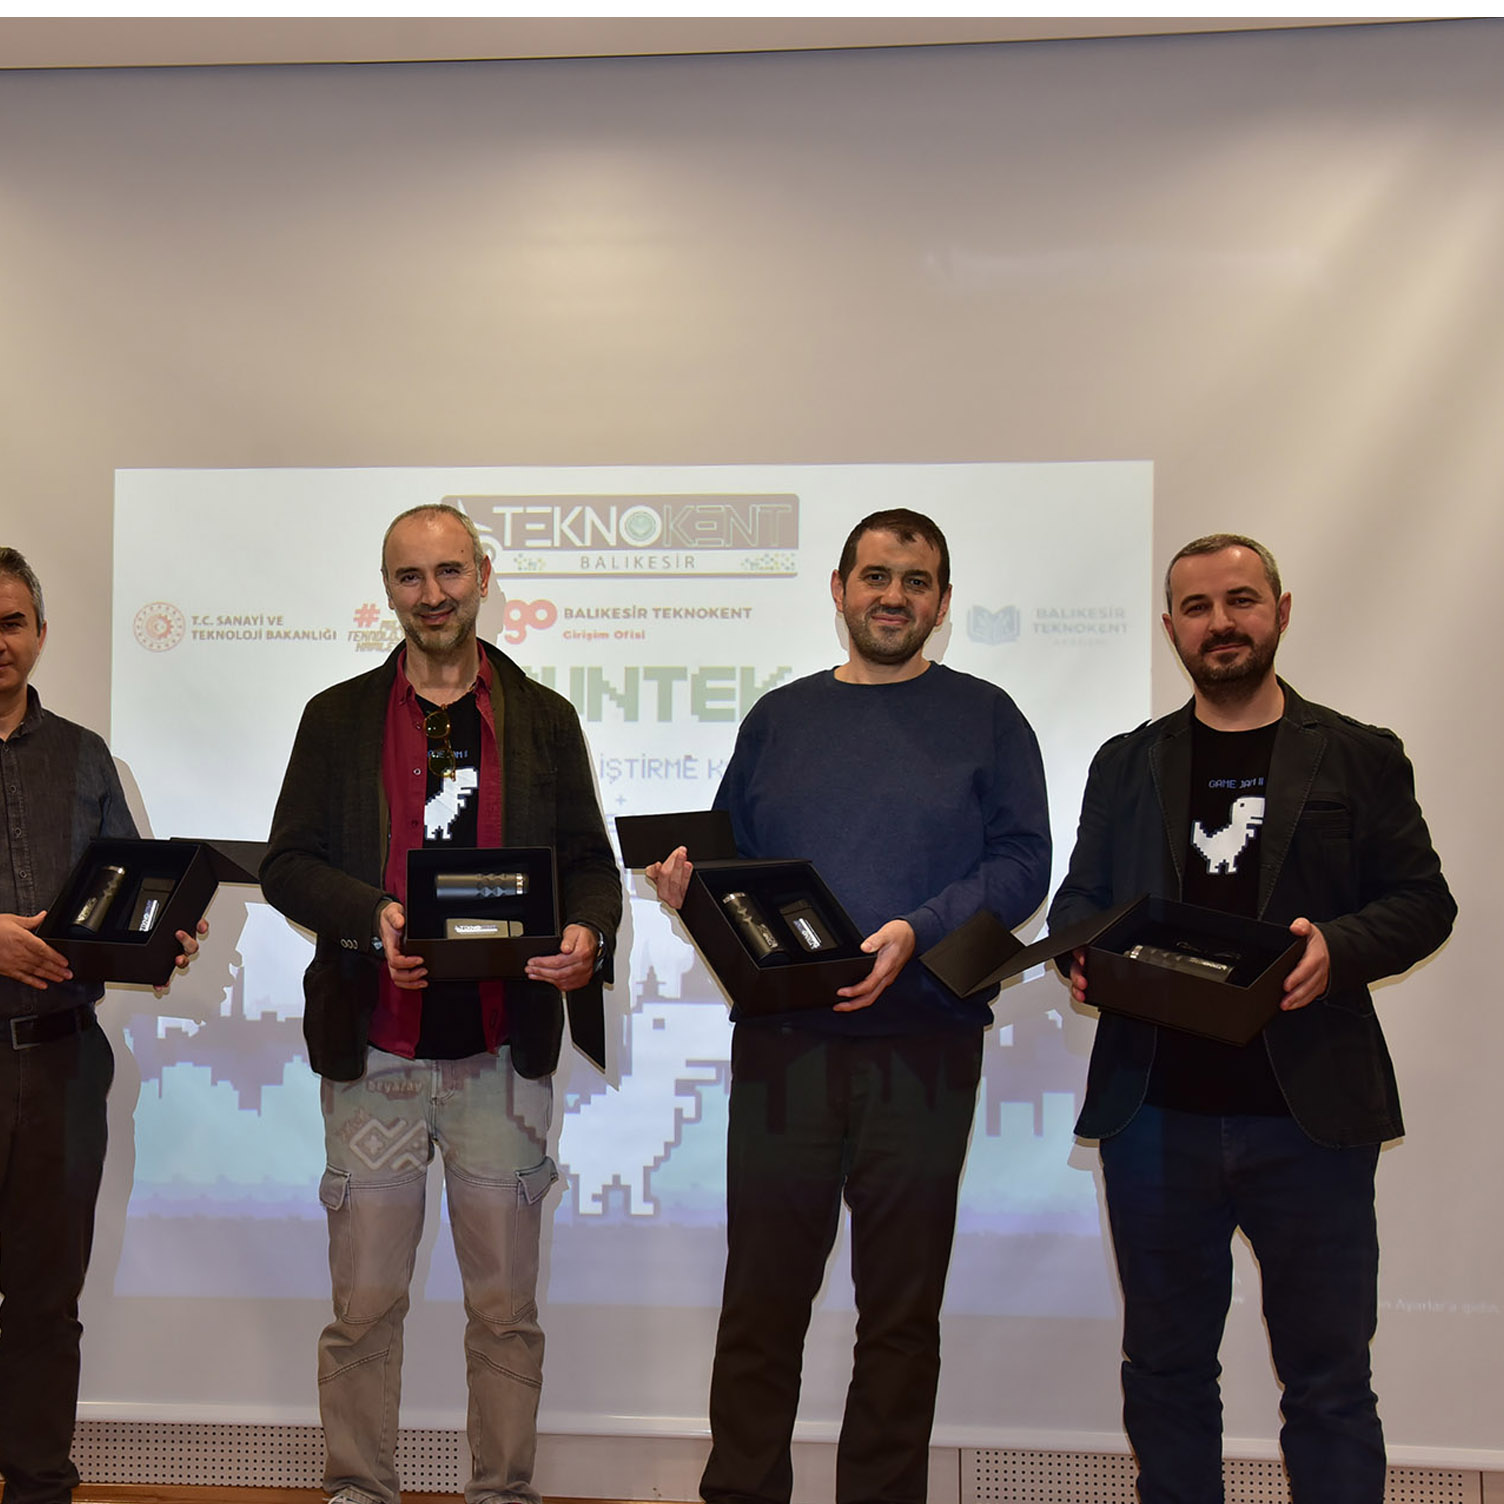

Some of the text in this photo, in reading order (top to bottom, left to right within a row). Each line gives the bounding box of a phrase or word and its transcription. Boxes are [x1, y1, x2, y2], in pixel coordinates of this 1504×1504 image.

[493, 505, 793, 547] TEKNOKENT
[580, 554, 696, 570] BALIKESİR
[192, 613, 284, 626] T.C. SANAYİ VE
[564, 605, 753, 620] BALIKESİR TEKNOKENT
[504, 599, 558, 645] go
[192, 627, 337, 641] TEKNOLOJİ BAKANLIĞI
[563, 629, 646, 641] Girişim Ofisi
[599, 753, 699, 784] İŞTİRME
